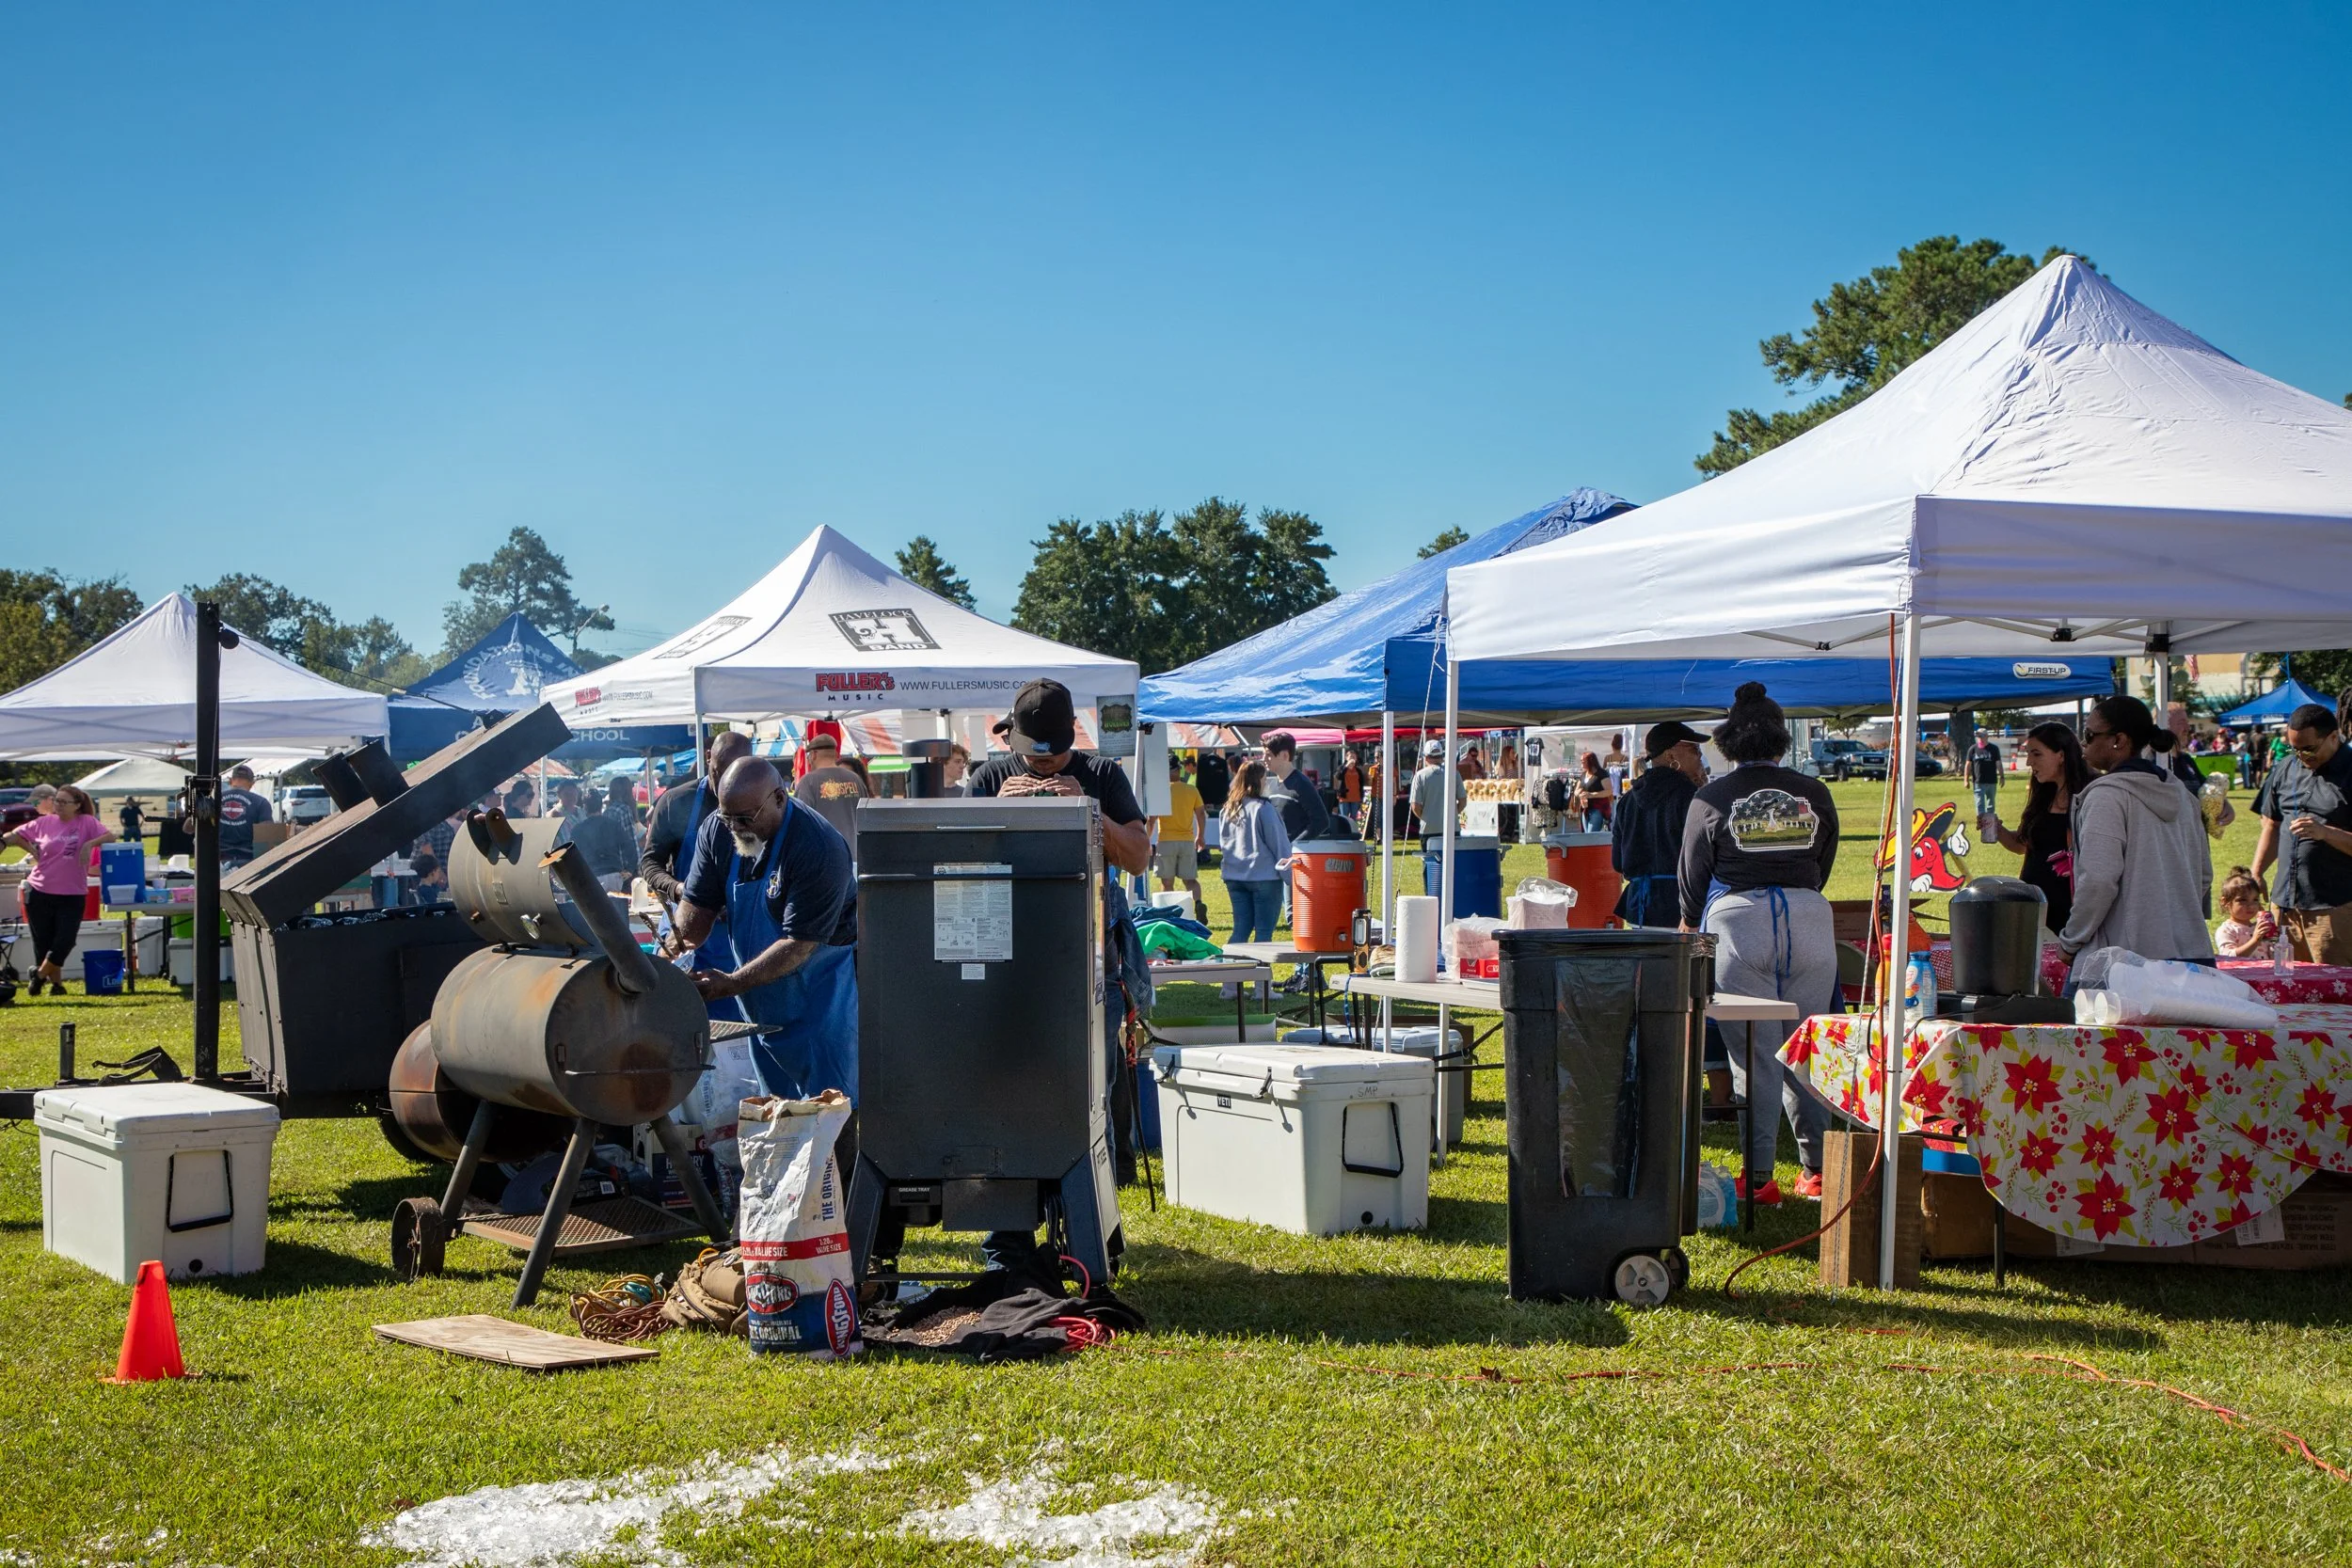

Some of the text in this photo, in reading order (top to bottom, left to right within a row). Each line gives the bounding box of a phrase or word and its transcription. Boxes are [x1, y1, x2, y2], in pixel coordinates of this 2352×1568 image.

[833, 610, 912, 621] HAVELOCK
[900, 680, 1028, 689] WWW.FULLERSMUSIC.CO
[570, 730, 630, 742] CHOOL
[1217, 1096, 1231, 1107] YETI
[822, 1200, 834, 1221] THE
[755, 1246, 771, 1257] VALUE
[772, 1246, 788, 1257] SIZE
[831, 1243, 842, 1251] SIZE
[832, 1286, 850, 1350] KINGSFORD
[759, 1326, 803, 1340] ORIGINAL
